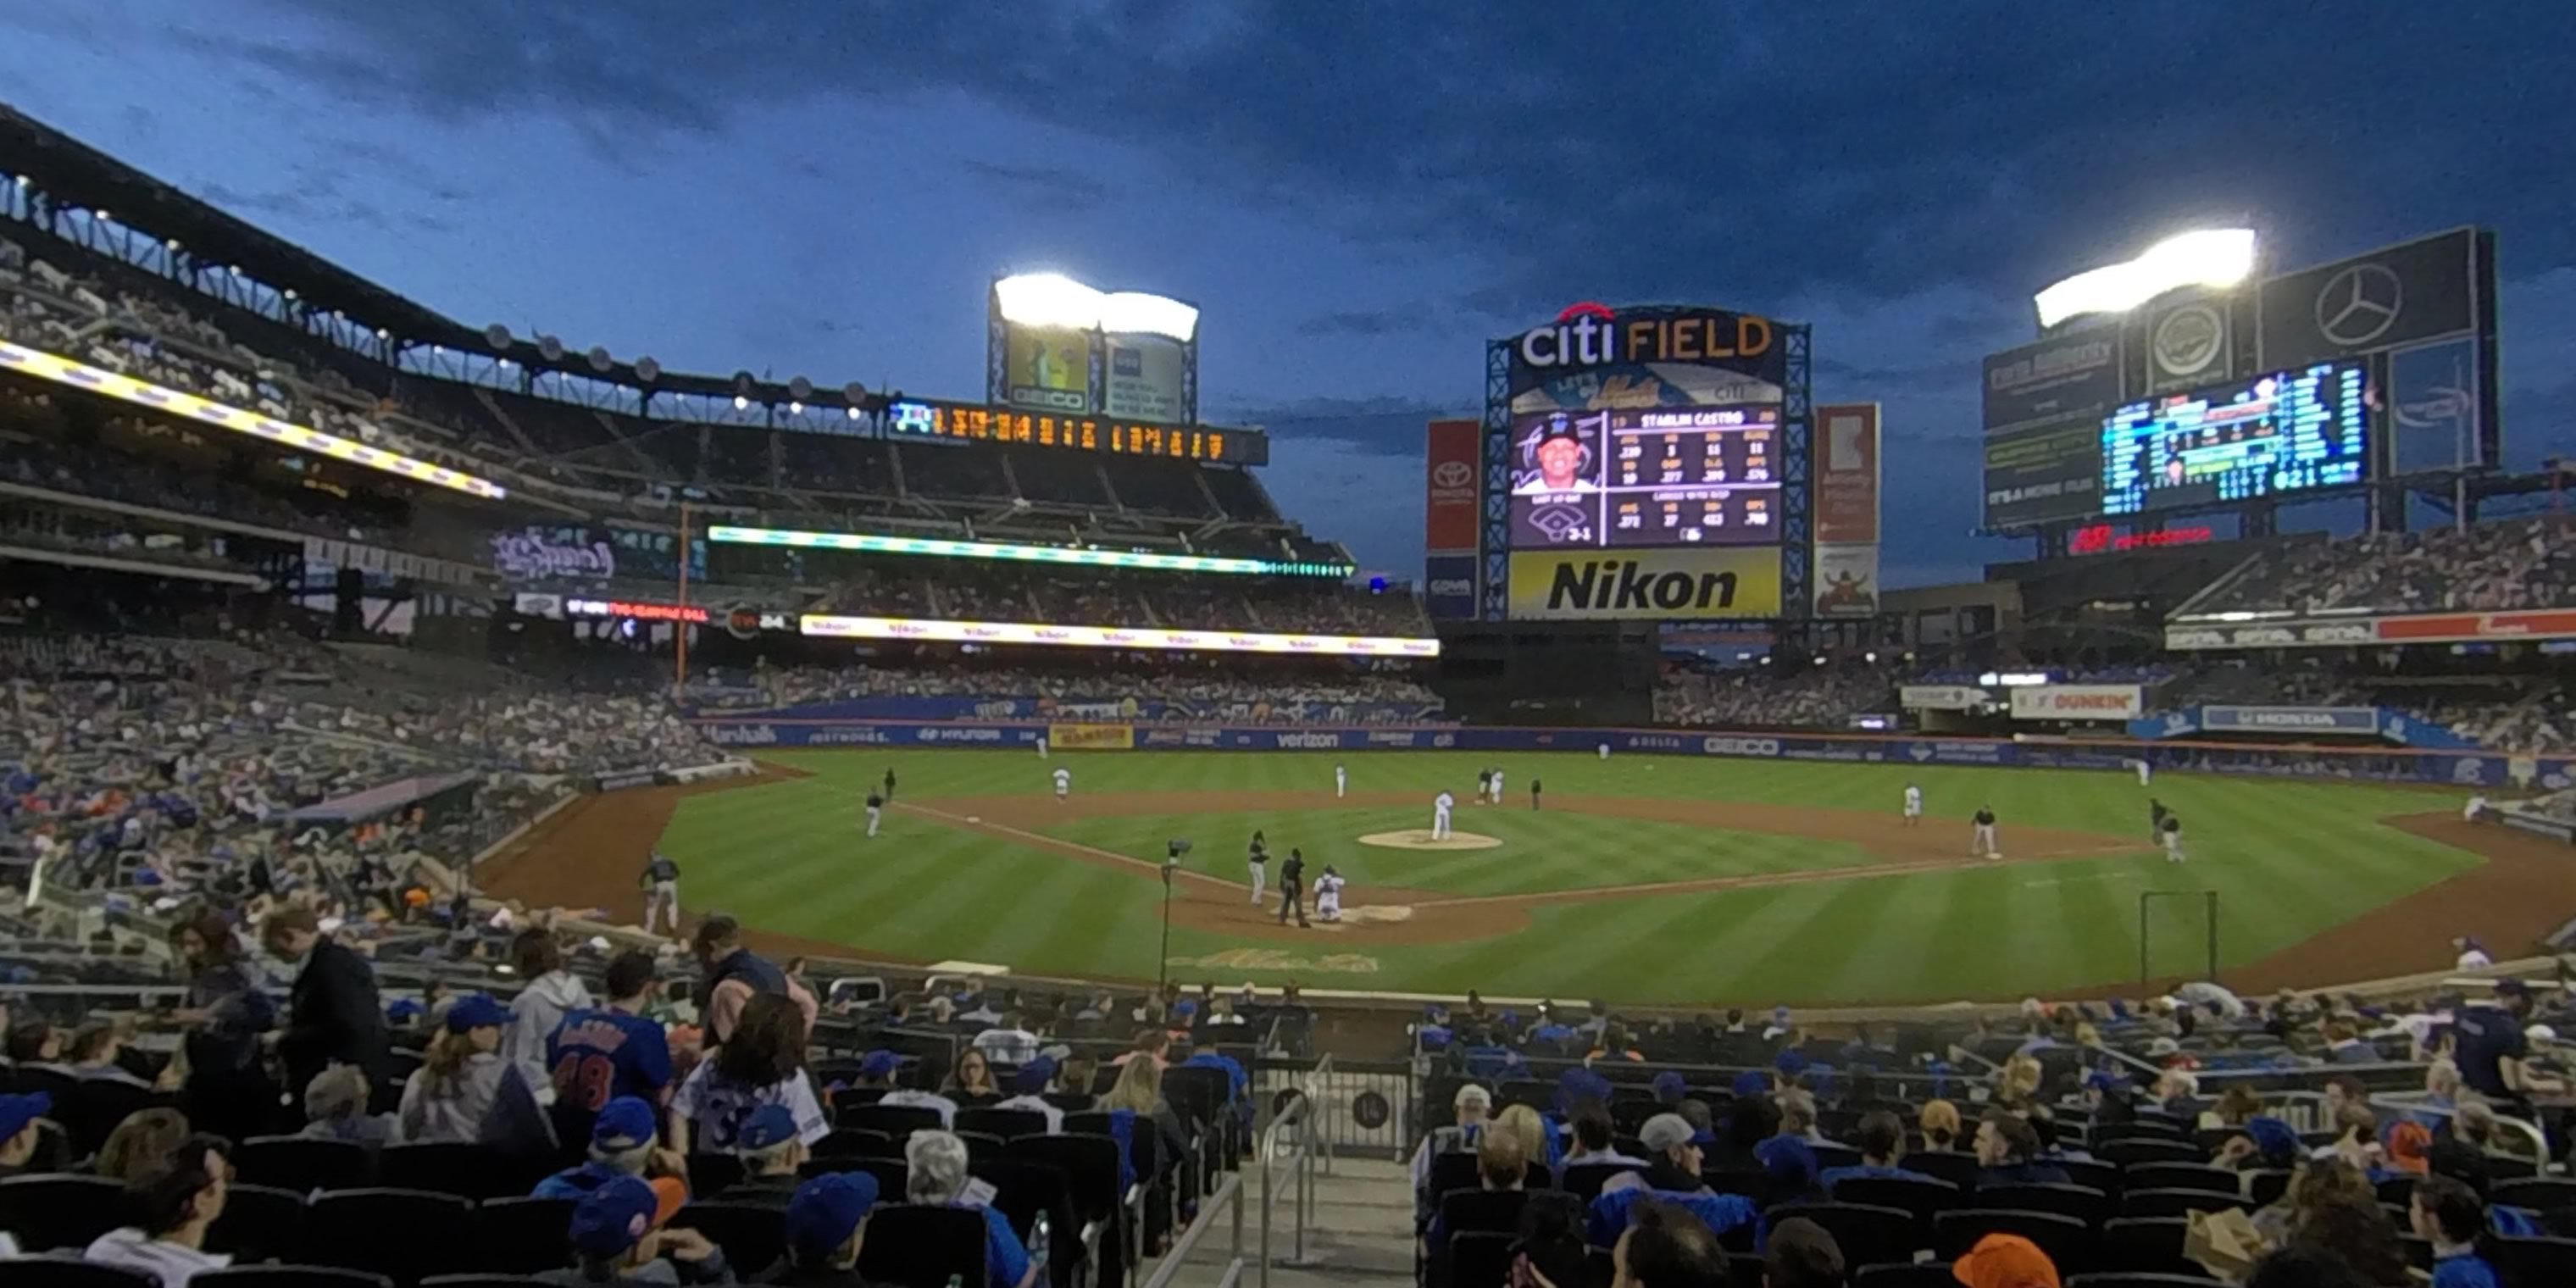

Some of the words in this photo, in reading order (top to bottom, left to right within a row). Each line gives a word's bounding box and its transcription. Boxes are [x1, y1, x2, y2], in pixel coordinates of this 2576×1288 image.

[1629, 315, 1772, 361] FIELD
[1013, 388, 1083, 408] GEICO
[1641, 413, 1693, 428] STARLIN
[1694, 410, 1746, 426] CASTRO
[1430, 578, 1472, 597] GOYA
[1546, 560, 1737, 610] Nikon
[2054, 693, 2134, 710] DUNKIN'
[2257, 713, 2336, 725] HONDA
[941, 729, 1002, 740] HYUNDAI
[1277, 731, 1339, 748] verizon
[1641, 736, 1679, 748] DELTA
[1703, 736, 1779, 756] GEICO
